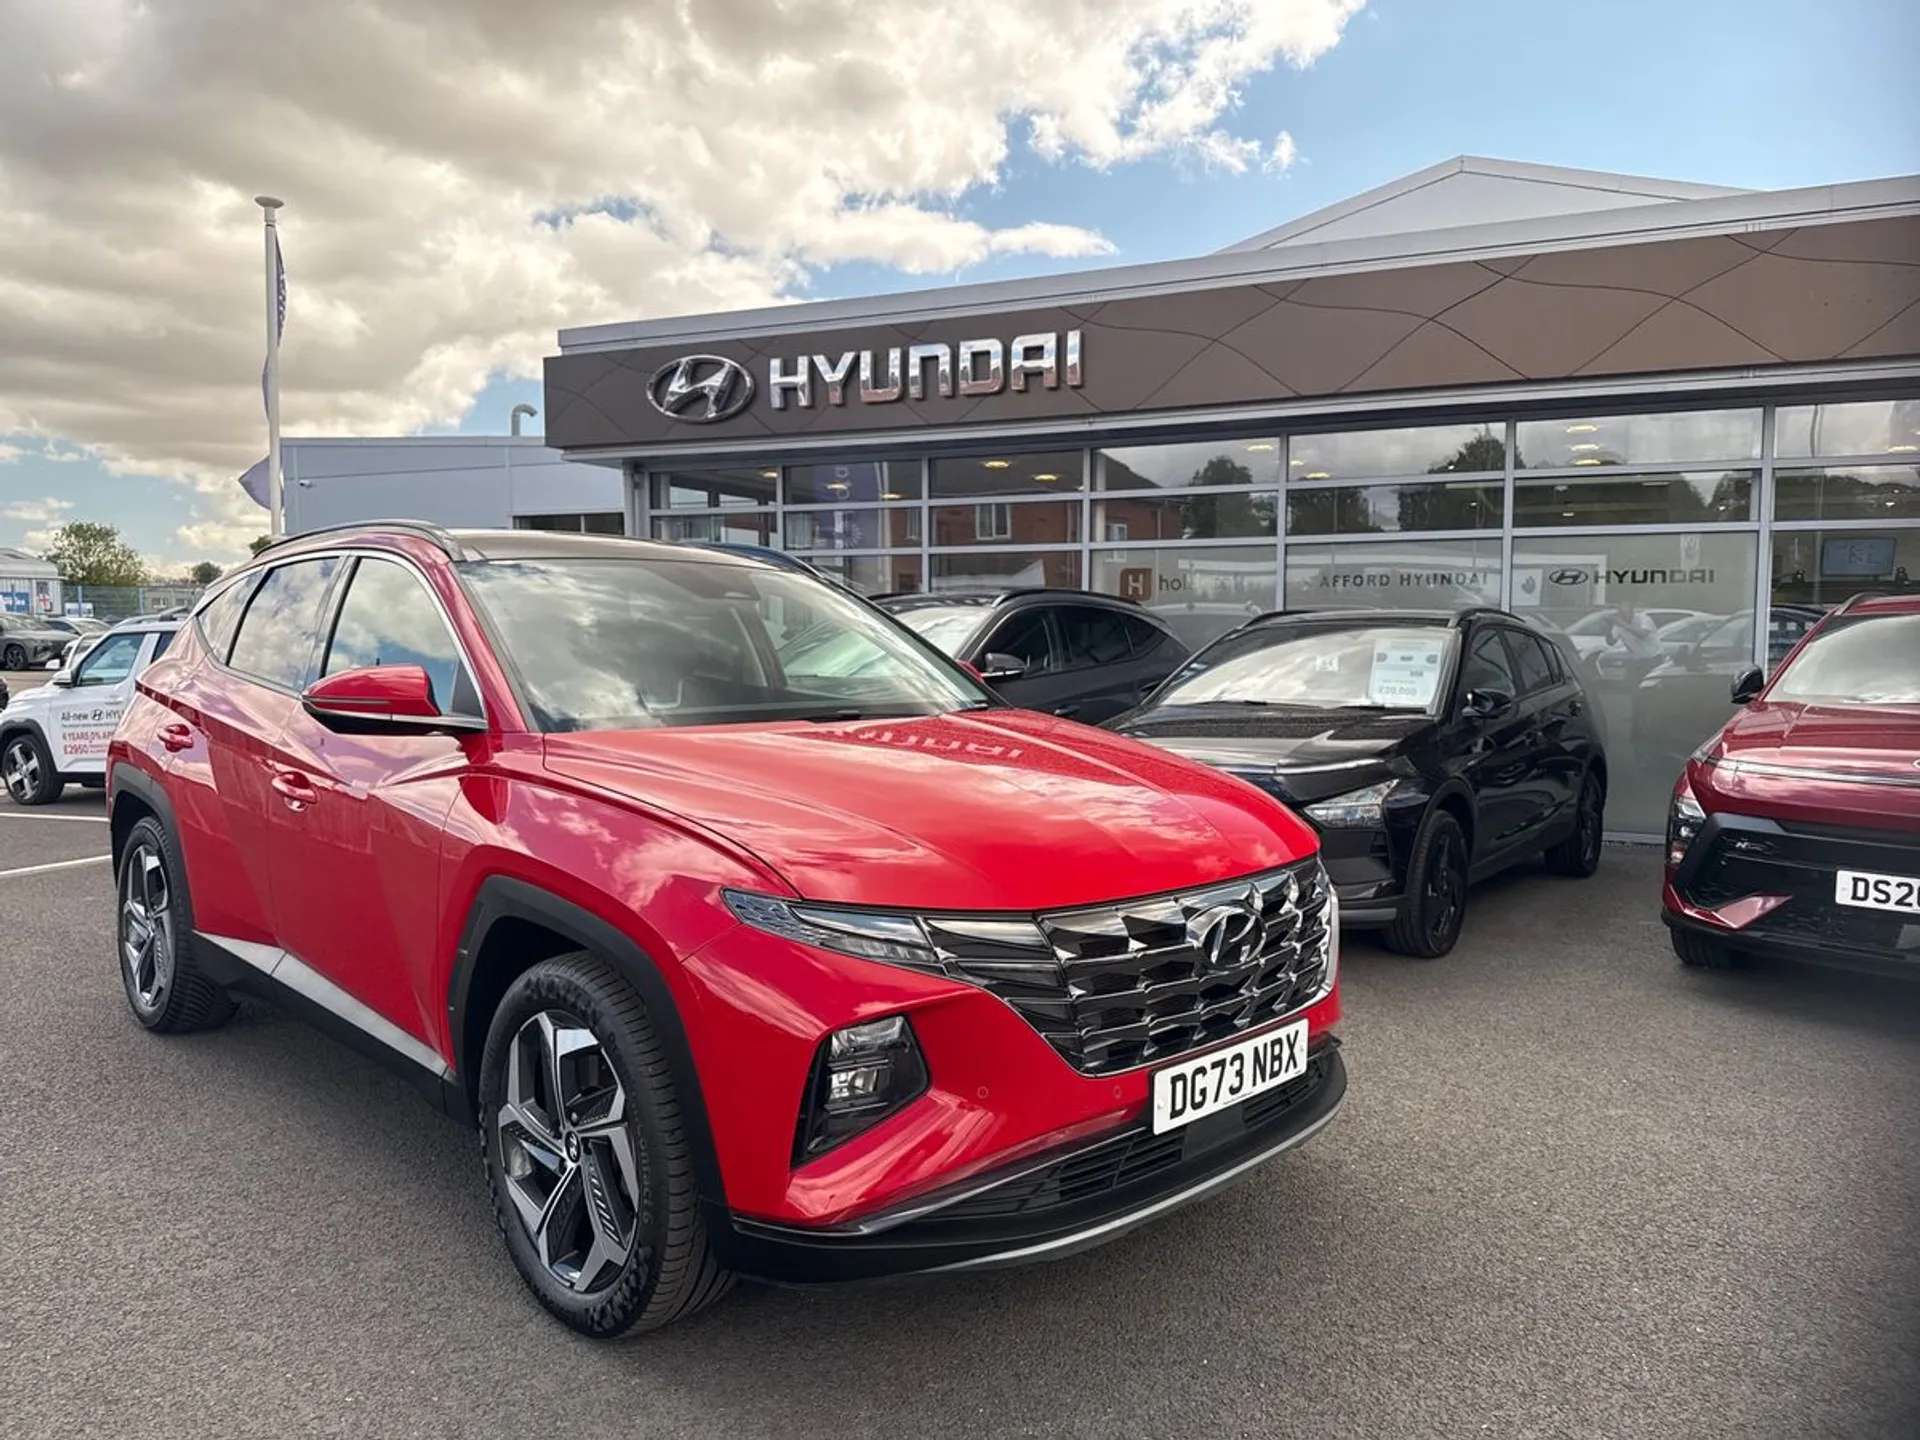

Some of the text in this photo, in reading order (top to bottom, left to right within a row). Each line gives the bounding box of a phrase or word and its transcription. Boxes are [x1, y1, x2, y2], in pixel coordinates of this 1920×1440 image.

[769, 329, 1084, 410] HYUNDAI
[1400, 572, 1488, 588] HYUNDAI
[1594, 569, 1714, 584] HYUNDAI
[1851, 877, 1920, 908] DS2
[1170, 1030, 1300, 1120] DG73 NBX
